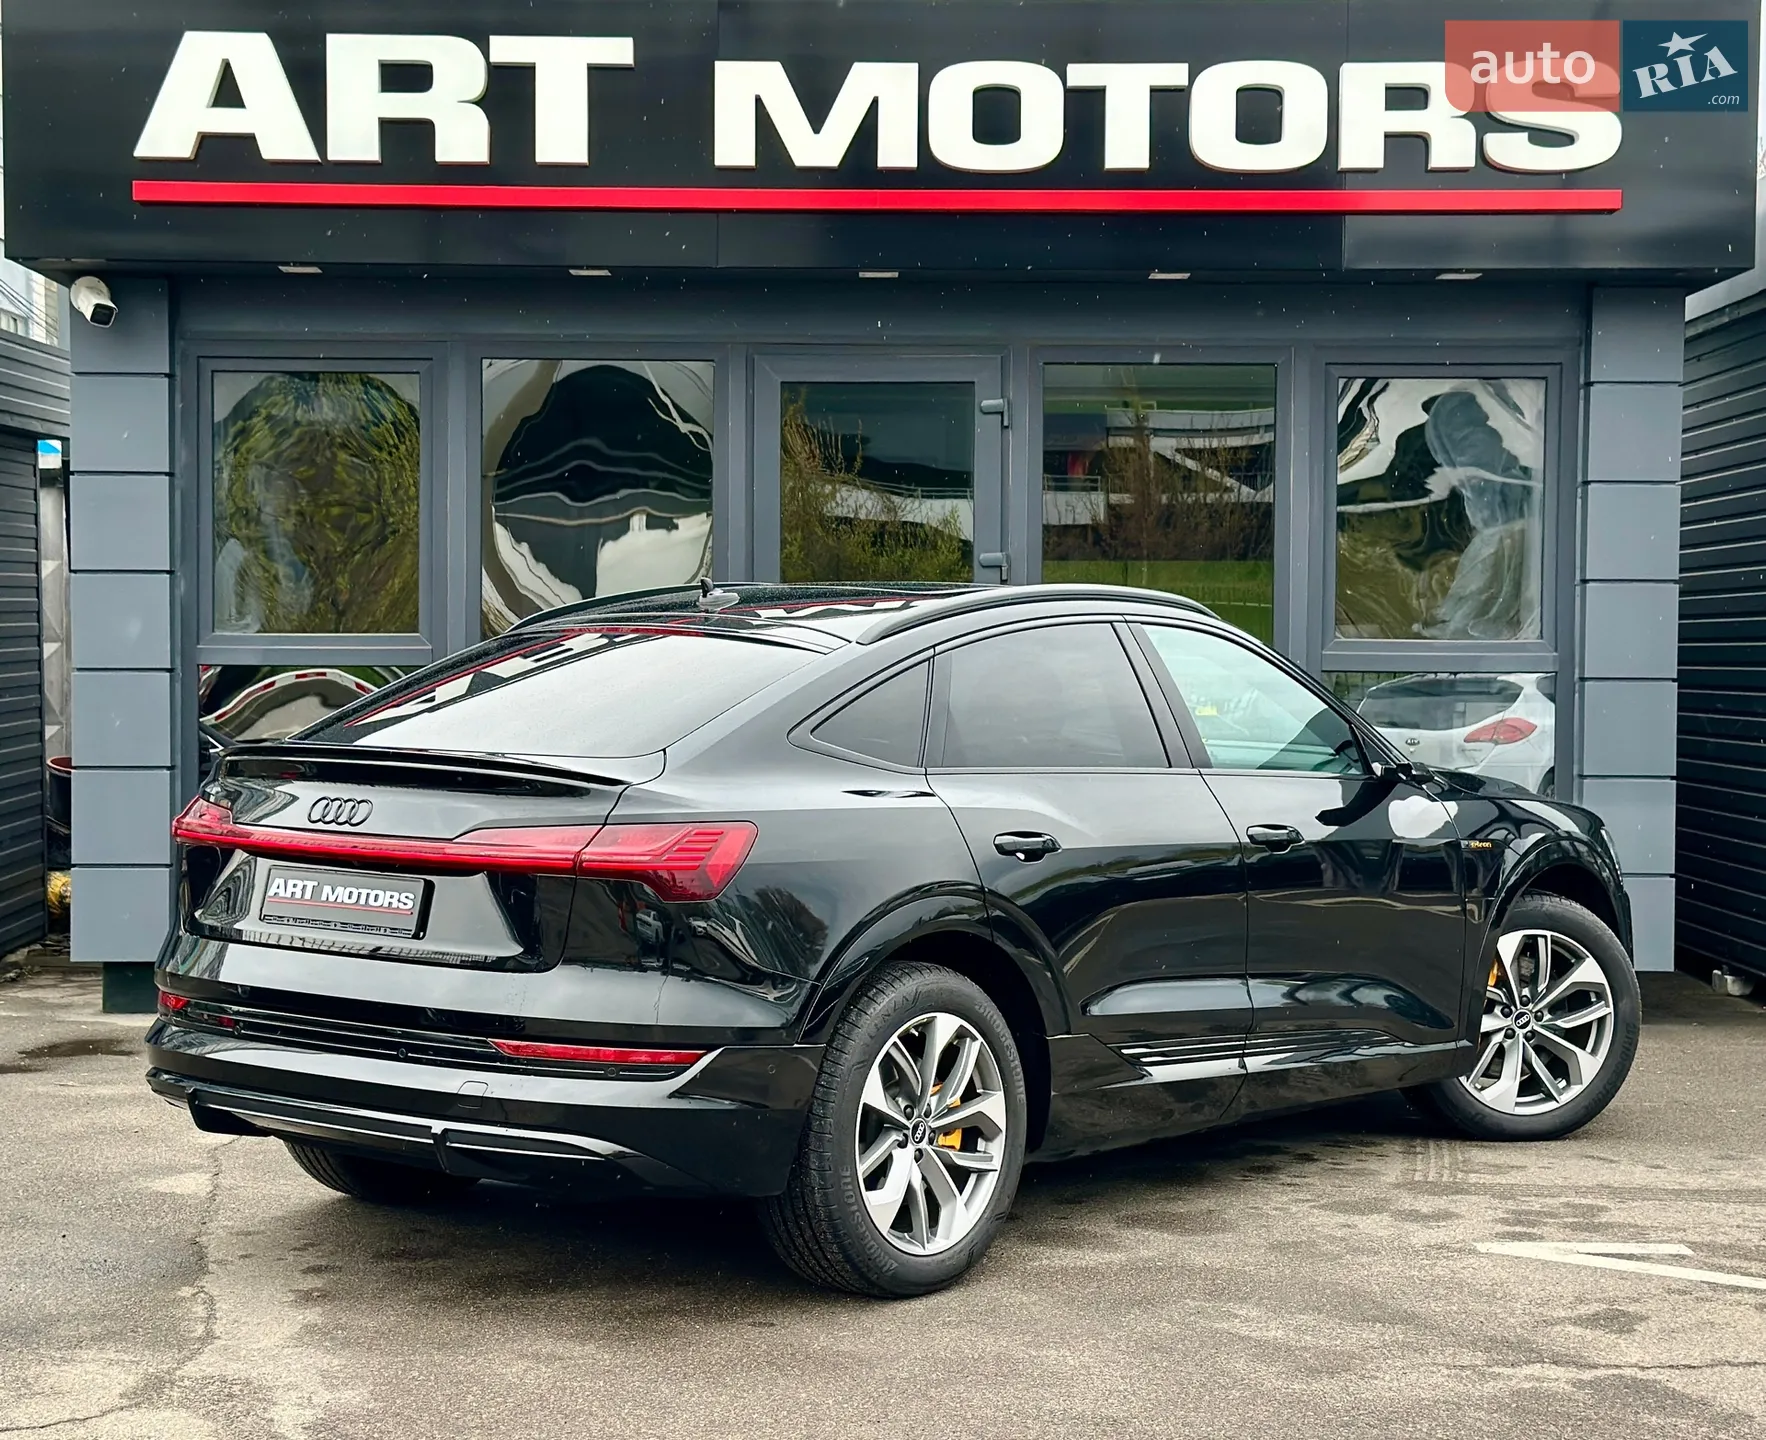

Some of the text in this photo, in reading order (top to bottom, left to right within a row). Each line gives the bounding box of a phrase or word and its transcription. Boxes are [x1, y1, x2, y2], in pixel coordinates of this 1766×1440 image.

[134, 31, 1623, 172] ART MOTORS
[267, 877, 415, 910] ART MOTORS
